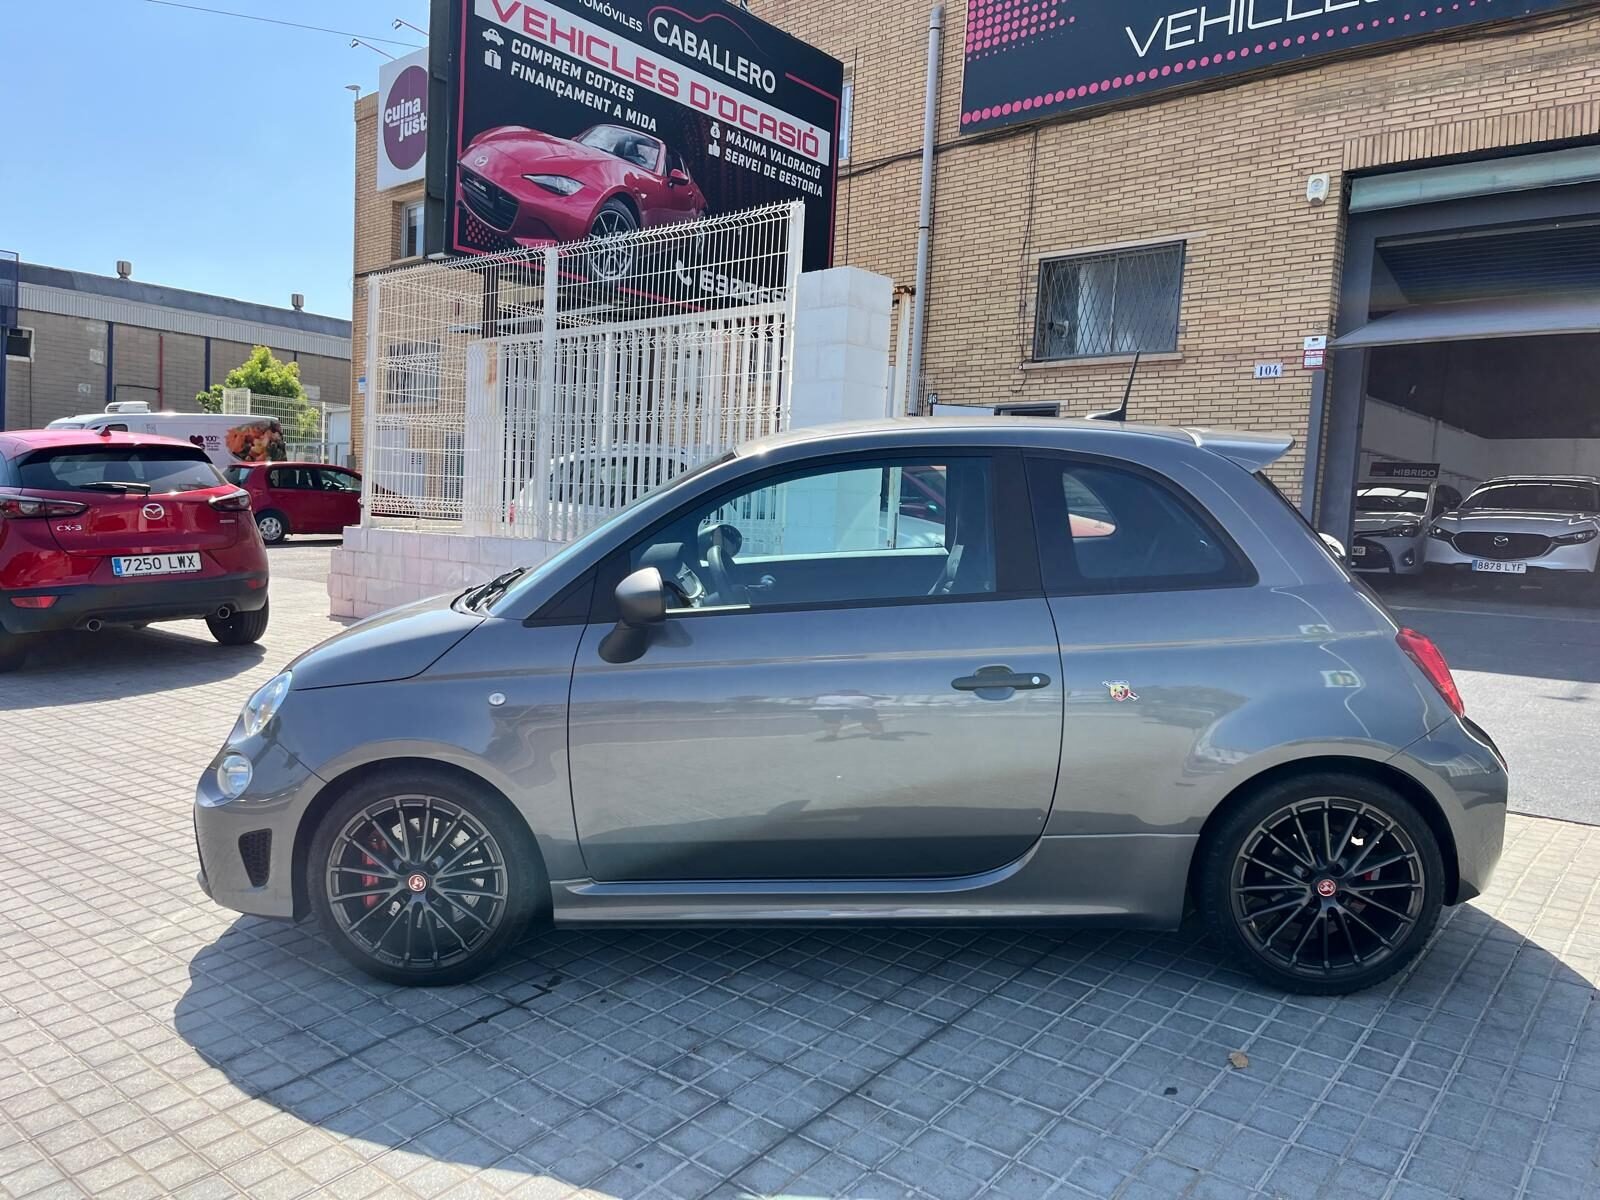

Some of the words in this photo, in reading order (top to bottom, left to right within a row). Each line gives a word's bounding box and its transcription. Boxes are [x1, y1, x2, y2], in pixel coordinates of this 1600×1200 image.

[1125, 0, 1380, 58] VEHICL
[492, 0, 680, 97] VEHICLES
[689, 81, 819, 158] D'OCASIÓ
[511, 39, 582, 80] COMPREM
[585, 70, 635, 102] COTXES
[653, 17, 776, 94] CABALLERO
[384, 97, 421, 124] cuina
[510, 61, 611, 113] FINANÇAMENT
[613, 104, 622, 119] A
[625, 108, 657, 132] MIDA
[398, 111, 428, 142] just
[724, 148, 761, 173] SERVEI
[764, 164, 776, 179] DE
[779, 170, 823, 198] GESTORIA
[725, 130, 767, 158] MÀXIMA
[770, 148, 821, 180] VALORACIÓ
[1259, 365, 1278, 377] 104
[123, 557, 162, 572] 7250
[168, 555, 196, 569] LWX
[1478, 561, 1502, 571] 8878
[1504, 563, 1523, 572] LYF
